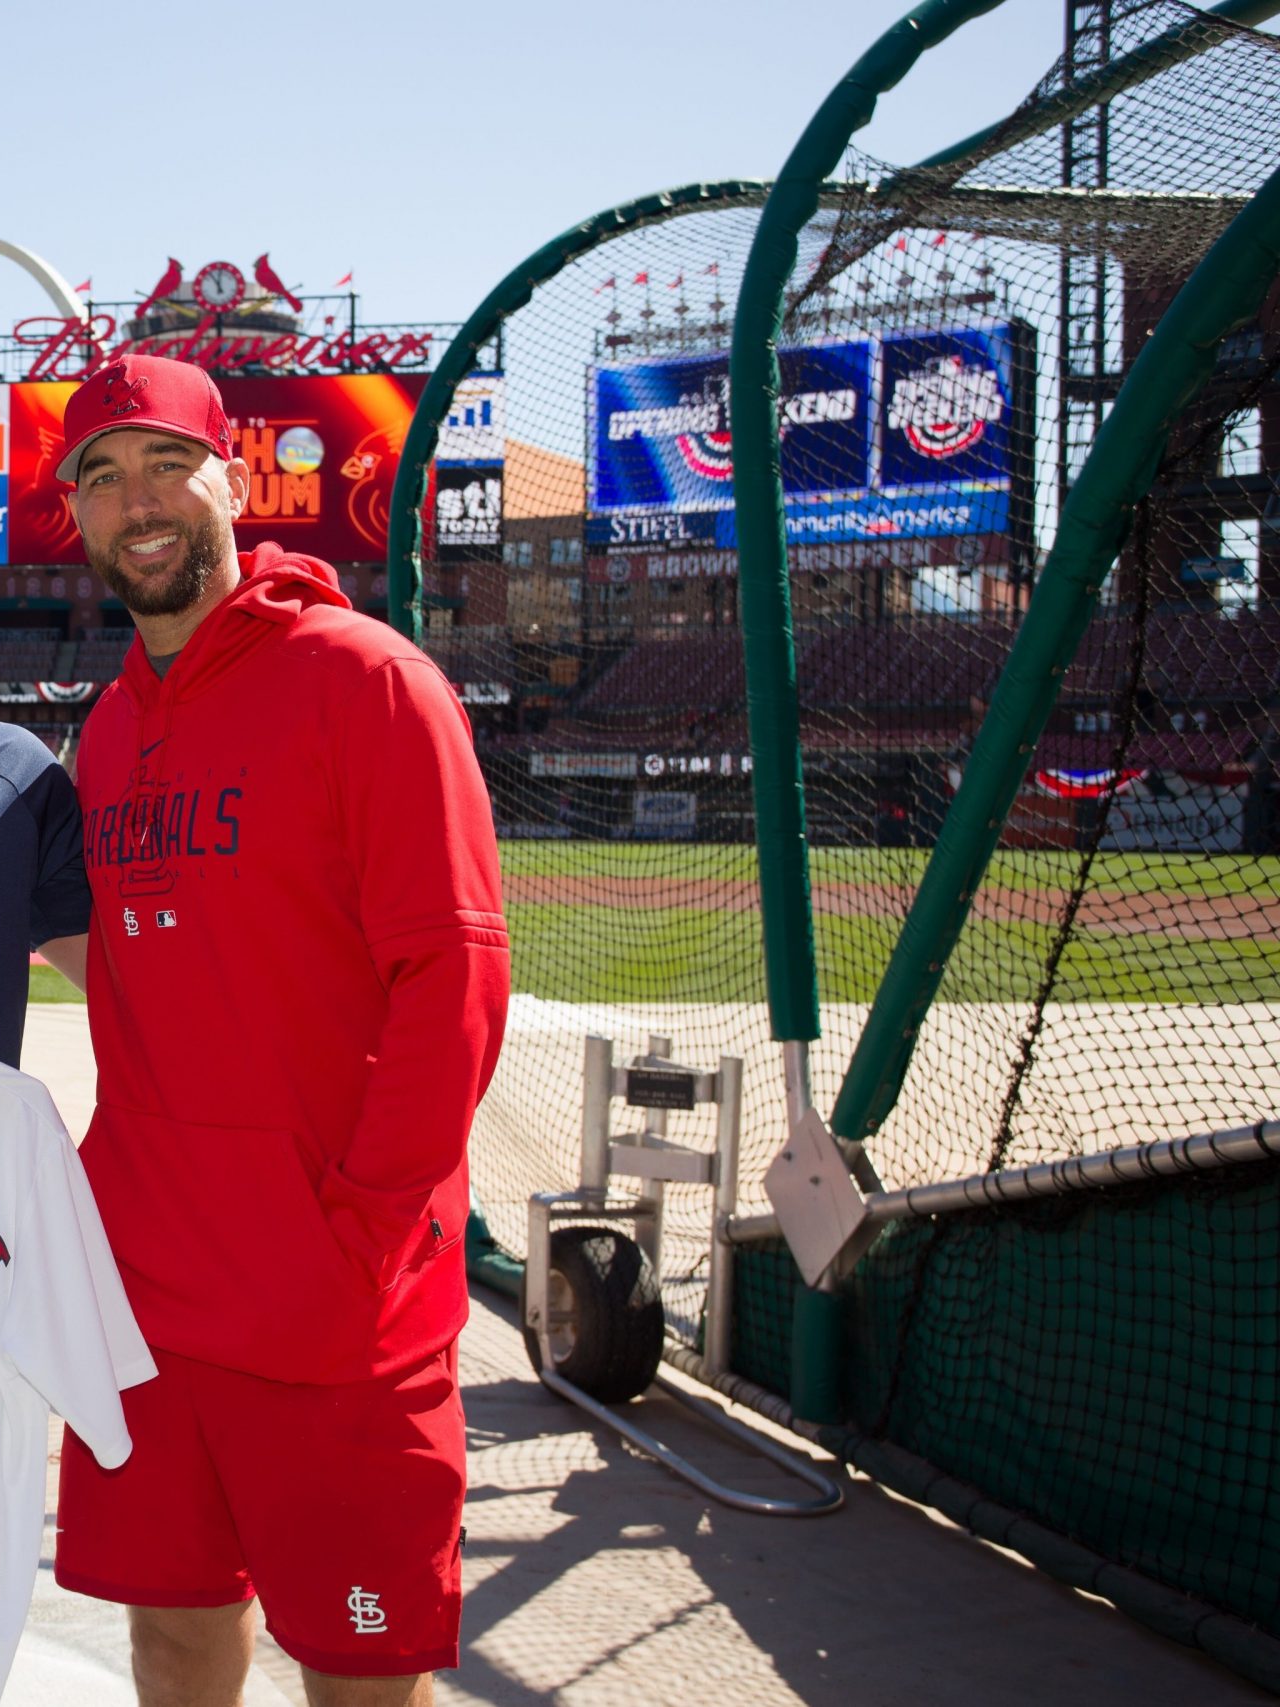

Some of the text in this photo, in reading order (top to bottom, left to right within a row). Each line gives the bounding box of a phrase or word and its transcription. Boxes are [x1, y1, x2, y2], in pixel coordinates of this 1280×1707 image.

[14, 313, 432, 382] Budweiser
[438, 519, 500, 533] TODAY
[609, 514, 694, 543] STIFEL
[84, 788, 242, 870] ARDINALS
